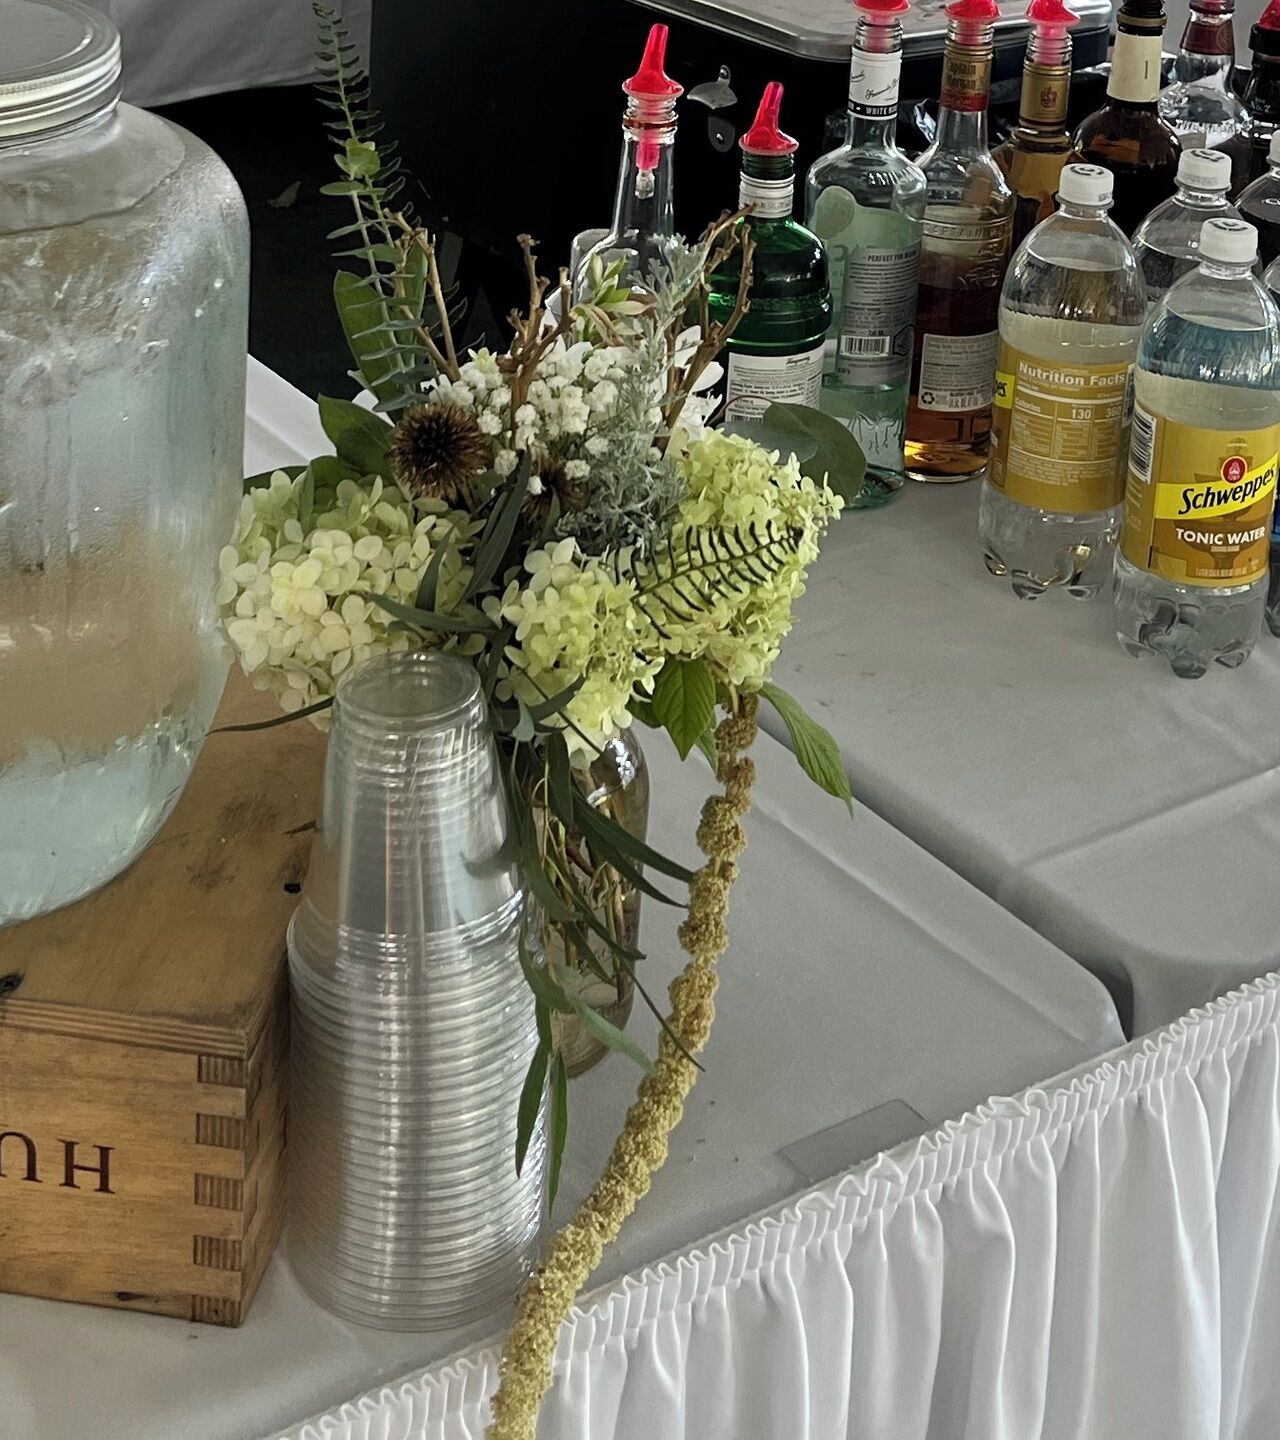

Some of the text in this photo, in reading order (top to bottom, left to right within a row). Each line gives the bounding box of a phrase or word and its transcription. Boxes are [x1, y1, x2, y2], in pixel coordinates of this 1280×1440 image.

[1019, 361, 1125, 387] Nutrition Facts
[1071, 407, 1092, 420] 130
[1177, 462, 1276, 515] Schweppes
[1176, 527, 1224, 545] TONIC
[1227, 526, 1266, 545] WATER
